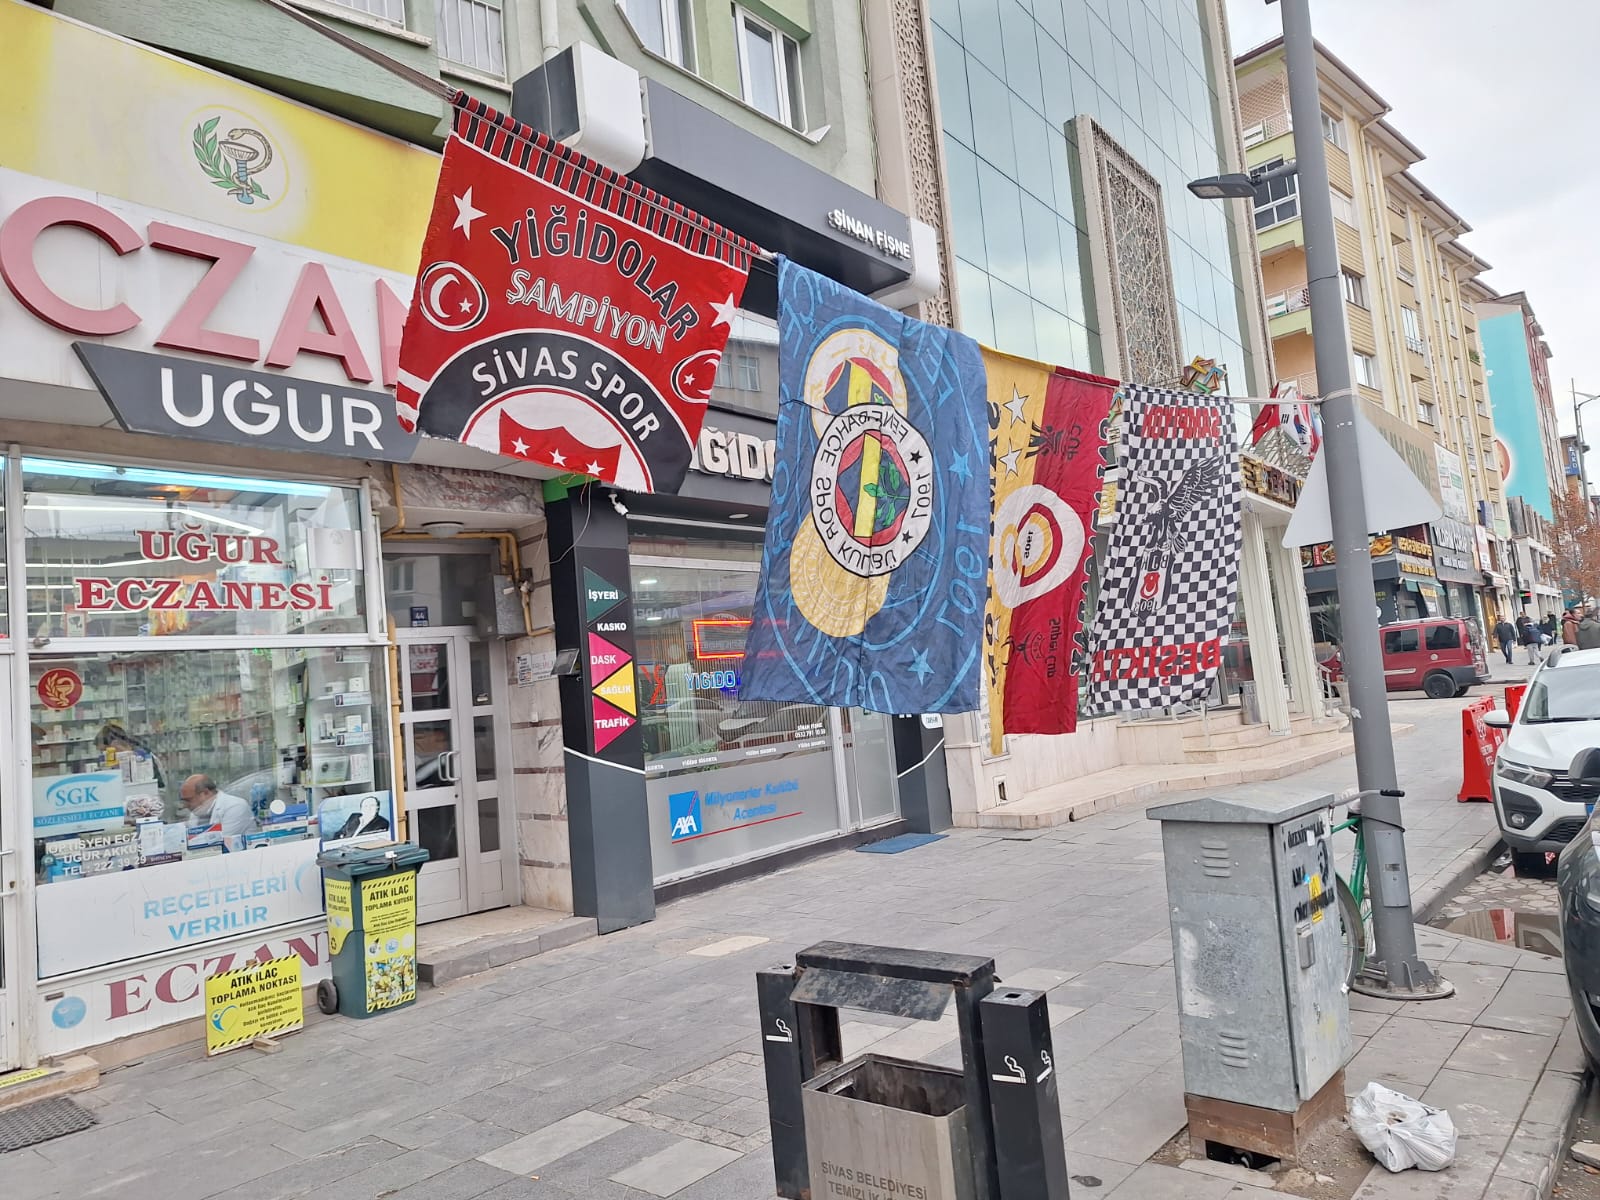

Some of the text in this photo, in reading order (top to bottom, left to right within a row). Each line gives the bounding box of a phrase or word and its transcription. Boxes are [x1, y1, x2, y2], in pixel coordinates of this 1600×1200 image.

[828, 208, 912, 260] SİNAN FİŞNE
[490, 205, 700, 341] YİĞİDOLAR
[506, 268, 667, 353] ŞAMPİYON
[471, 346, 661, 442] SİVAS SPOR
[135, 524, 283, 565] UĞUR
[74, 575, 335, 611] ECZANESİ
[588, 589, 619, 601] İŞYERİ
[597, 623, 627, 632] KASKO
[591, 655, 617, 665] DASK
[600, 685, 632, 695] SAĞLIK
[595, 716, 630, 729] TRAFİK
[55, 786, 100, 807] SGK
[672, 815, 697, 838] AXA
[144, 870, 288, 919] REÇETELERİ
[365, 900, 392, 912] TOPLAMA
[370, 889, 389, 901] ATIK
[168, 905, 268, 941] VERİLİR
[211, 986, 256, 1006] TOPLAMA
[260, 975, 297, 992] NOKTASI
[231, 973, 252, 989] ATIK
[821, 1160, 927, 1200] SİVAS BELEDİYESİ
